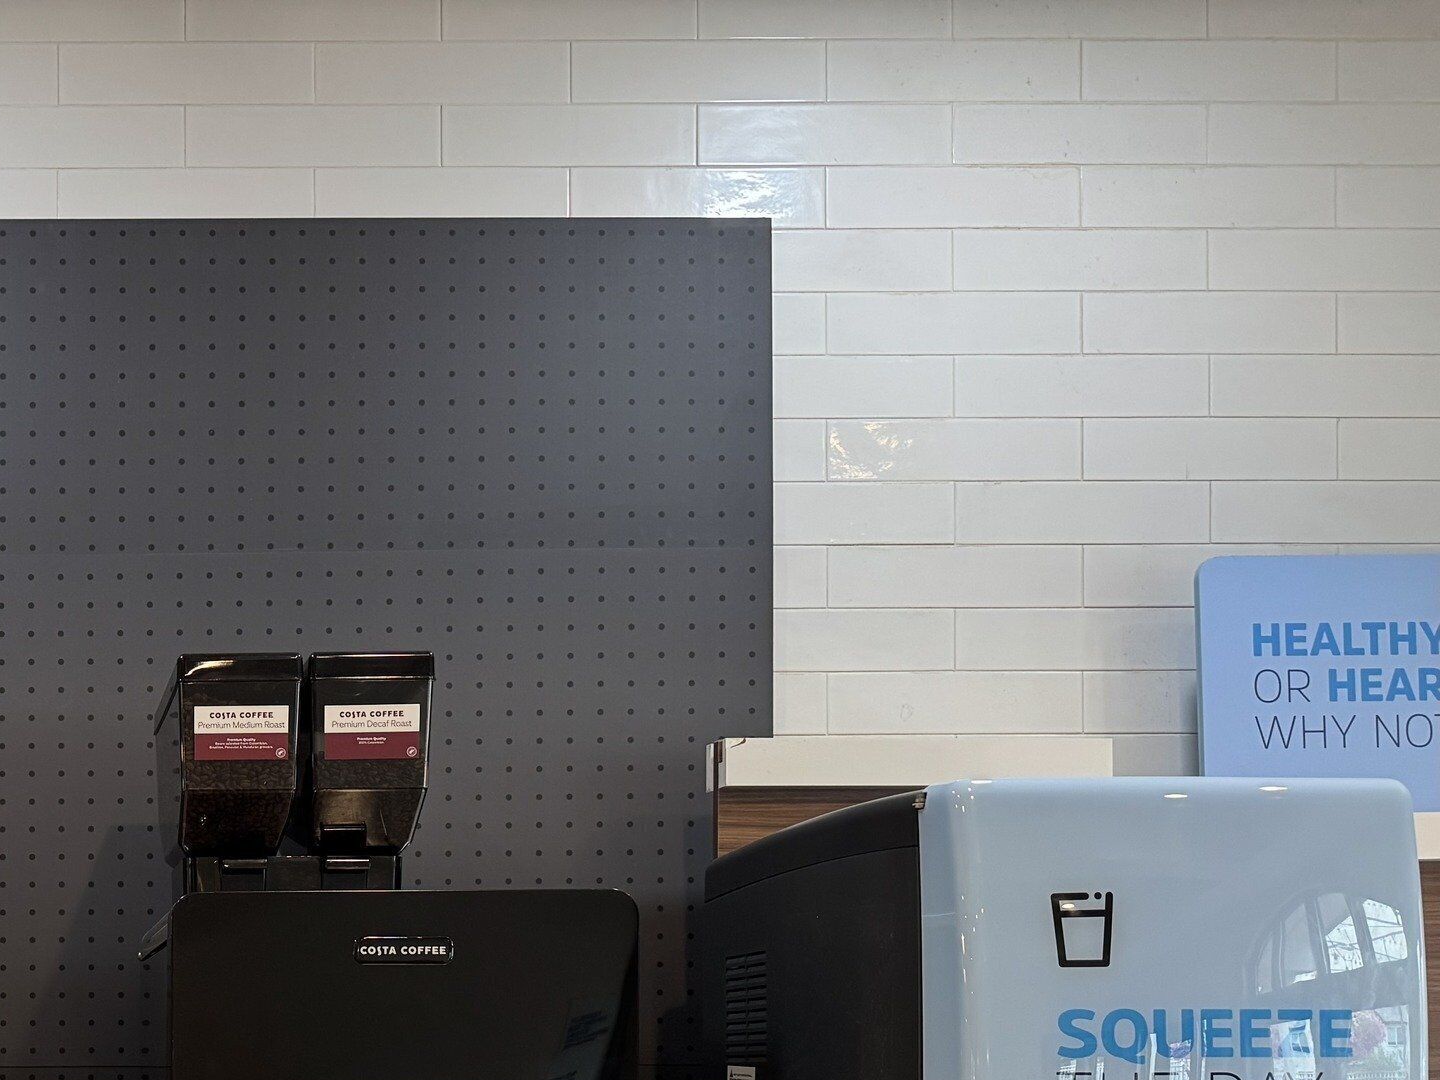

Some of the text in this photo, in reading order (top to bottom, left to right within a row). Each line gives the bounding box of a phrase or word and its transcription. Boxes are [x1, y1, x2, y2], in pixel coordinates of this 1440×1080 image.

[1252, 621, 1440, 657] HEALTHY
[1254, 669, 1311, 703] OR
[209, 711, 274, 720] COSTA COFFEE
[339, 710, 367, 719] COSTA
[197, 720, 286, 729] Premium Medium Roast
[331, 719, 413, 728] Premium Decaf Roast
[1254, 713, 1440, 750] WHY NO
[359, 945, 447, 956] COSTA COFFEE
